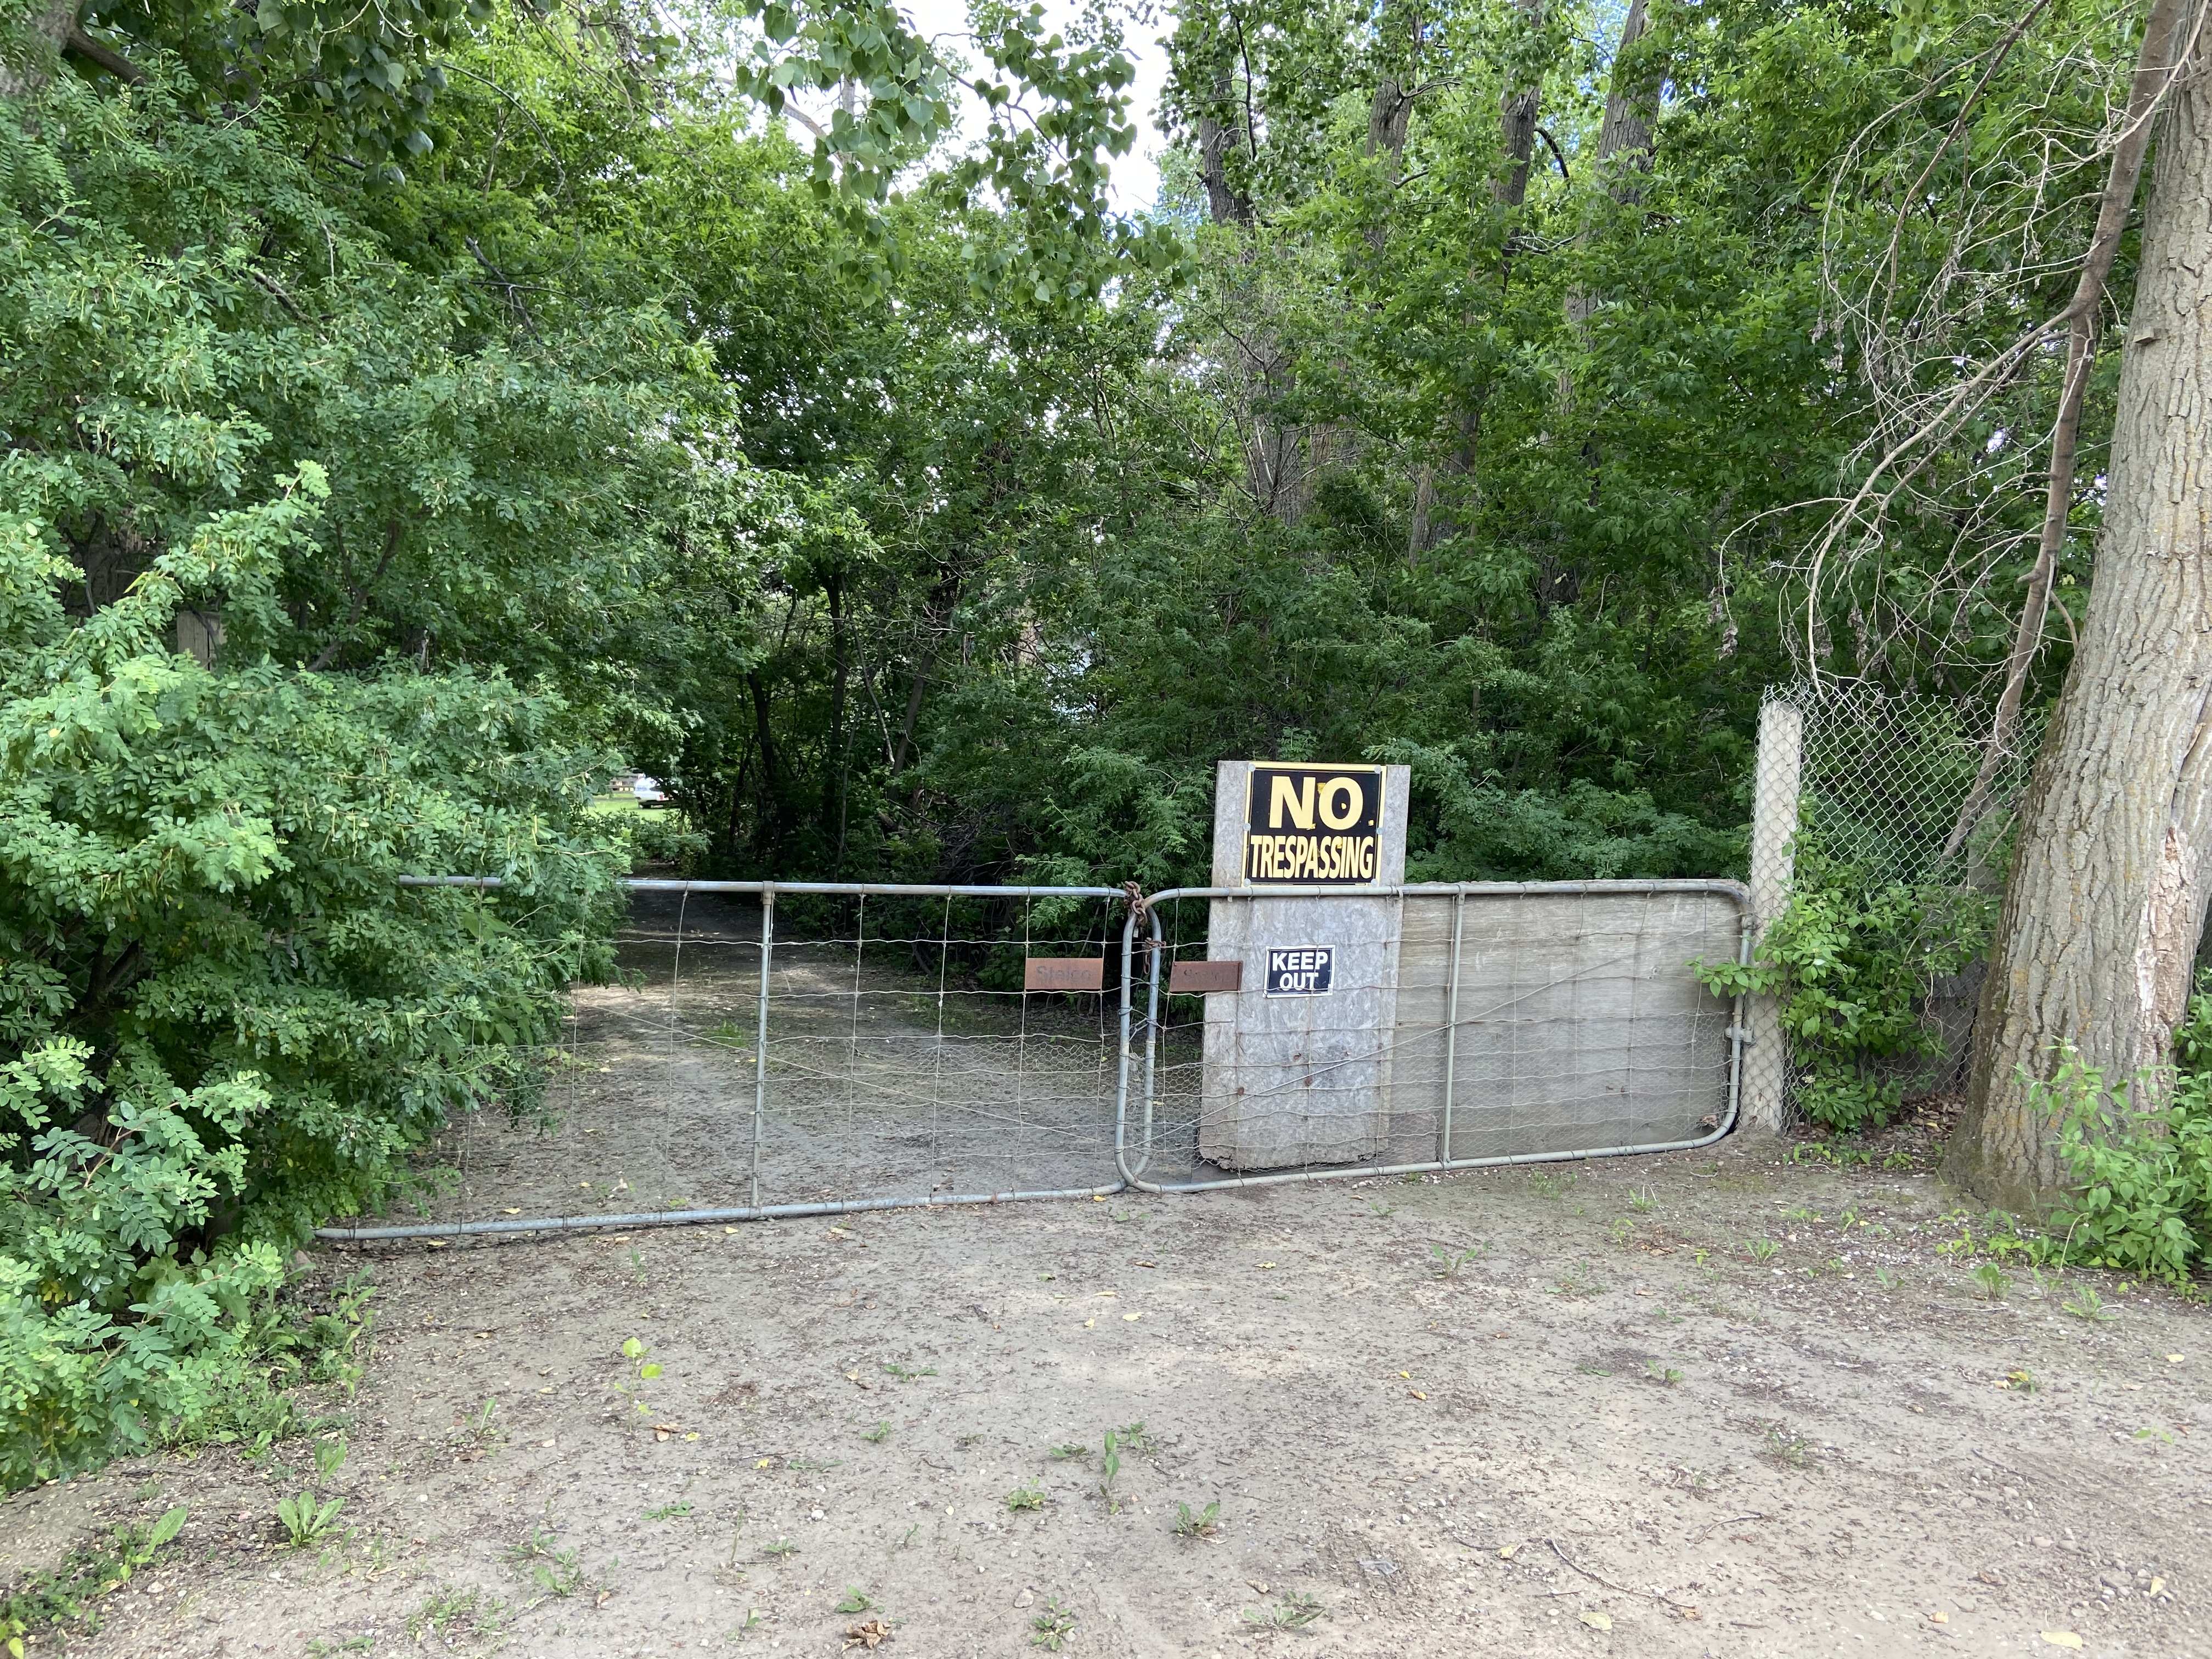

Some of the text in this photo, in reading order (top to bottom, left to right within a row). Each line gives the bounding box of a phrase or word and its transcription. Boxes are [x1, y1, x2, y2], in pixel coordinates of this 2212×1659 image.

[1269, 776, 1363, 830] NO
[1250, 835, 1374, 878] TRESPASSING
[1272, 951, 1328, 971] KEEP
[1279, 972, 1319, 991] OUT
